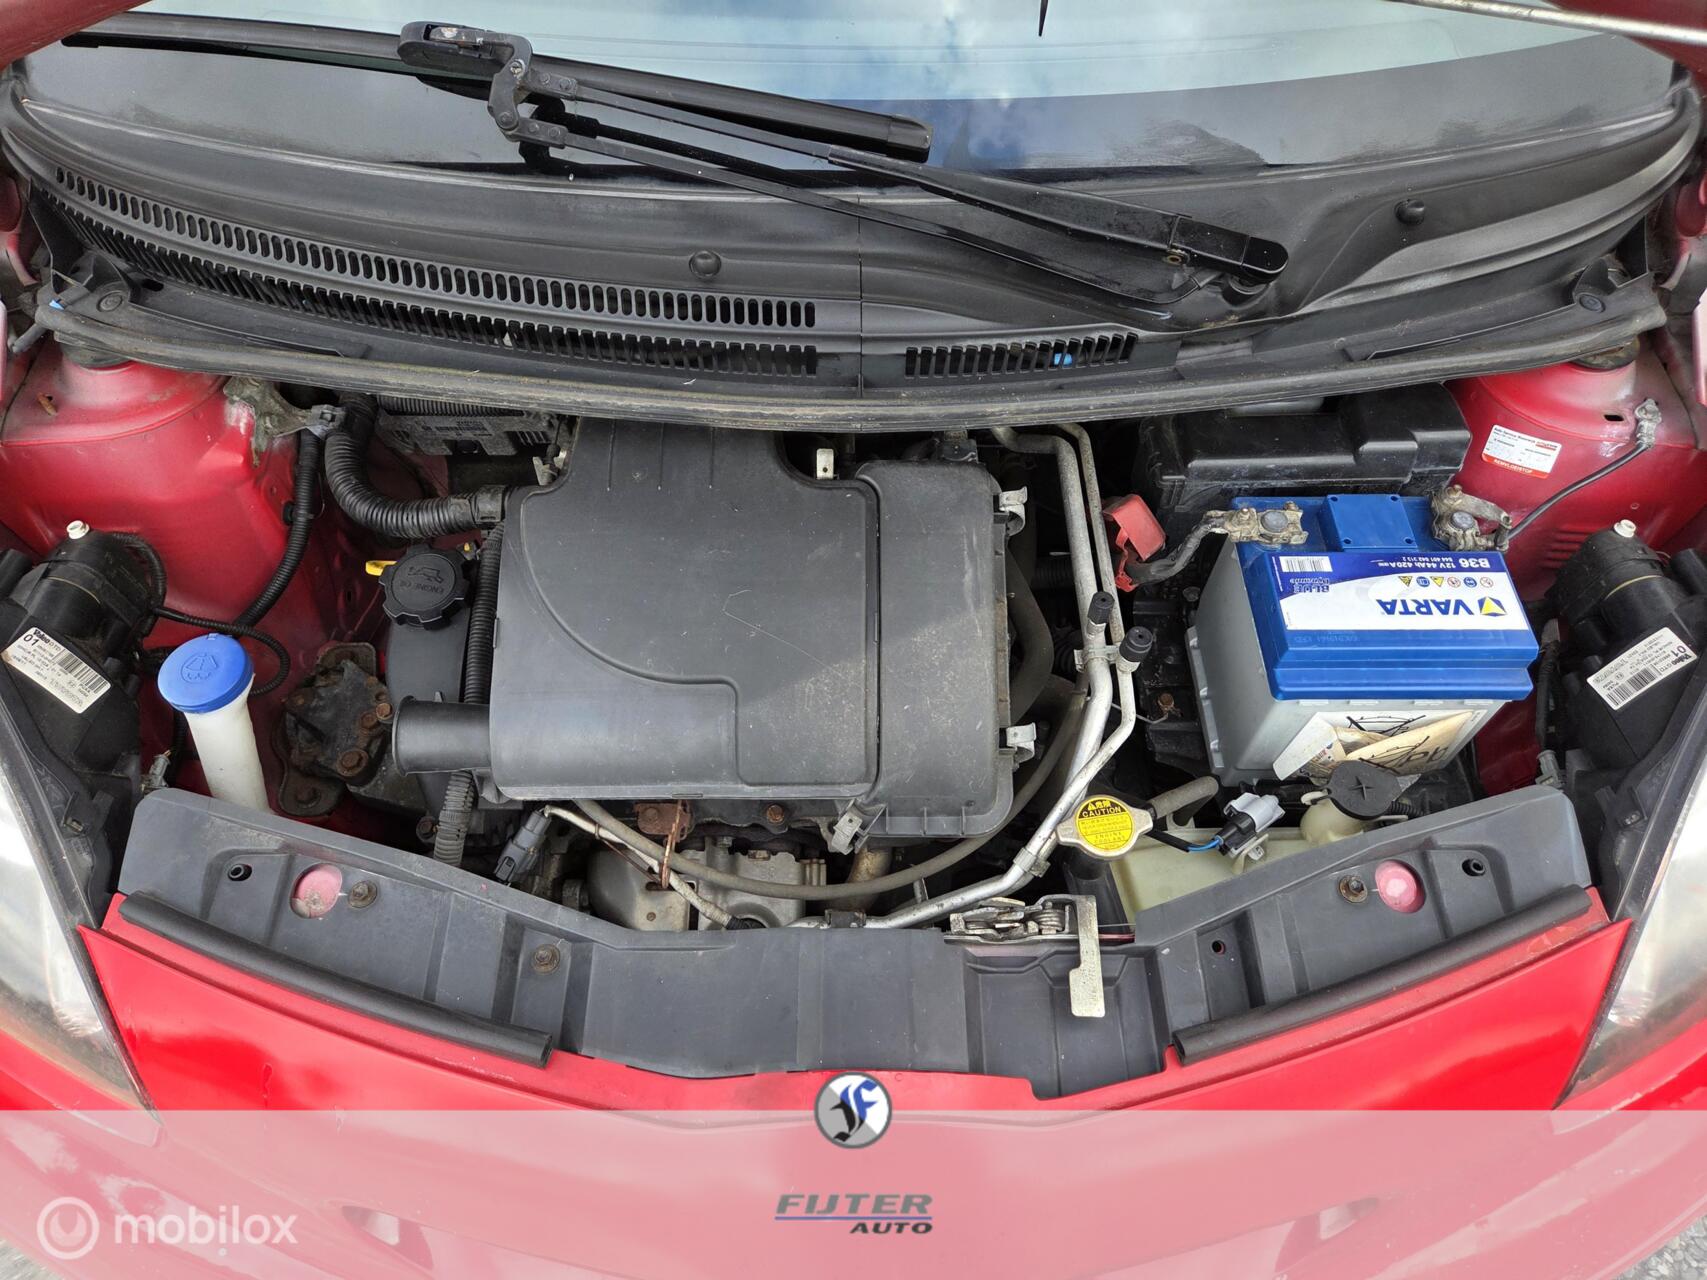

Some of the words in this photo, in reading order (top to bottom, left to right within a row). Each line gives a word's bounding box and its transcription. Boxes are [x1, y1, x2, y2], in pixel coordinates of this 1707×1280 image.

[1458, 557, 1491, 569] B36
[1293, 584, 1330, 593] BLUE
[1375, 599, 1475, 615] VARTA
[23, 634, 40, 646] 01
[1671, 645, 1687, 658] 01
[1082, 806, 1122, 818] CAUTION
